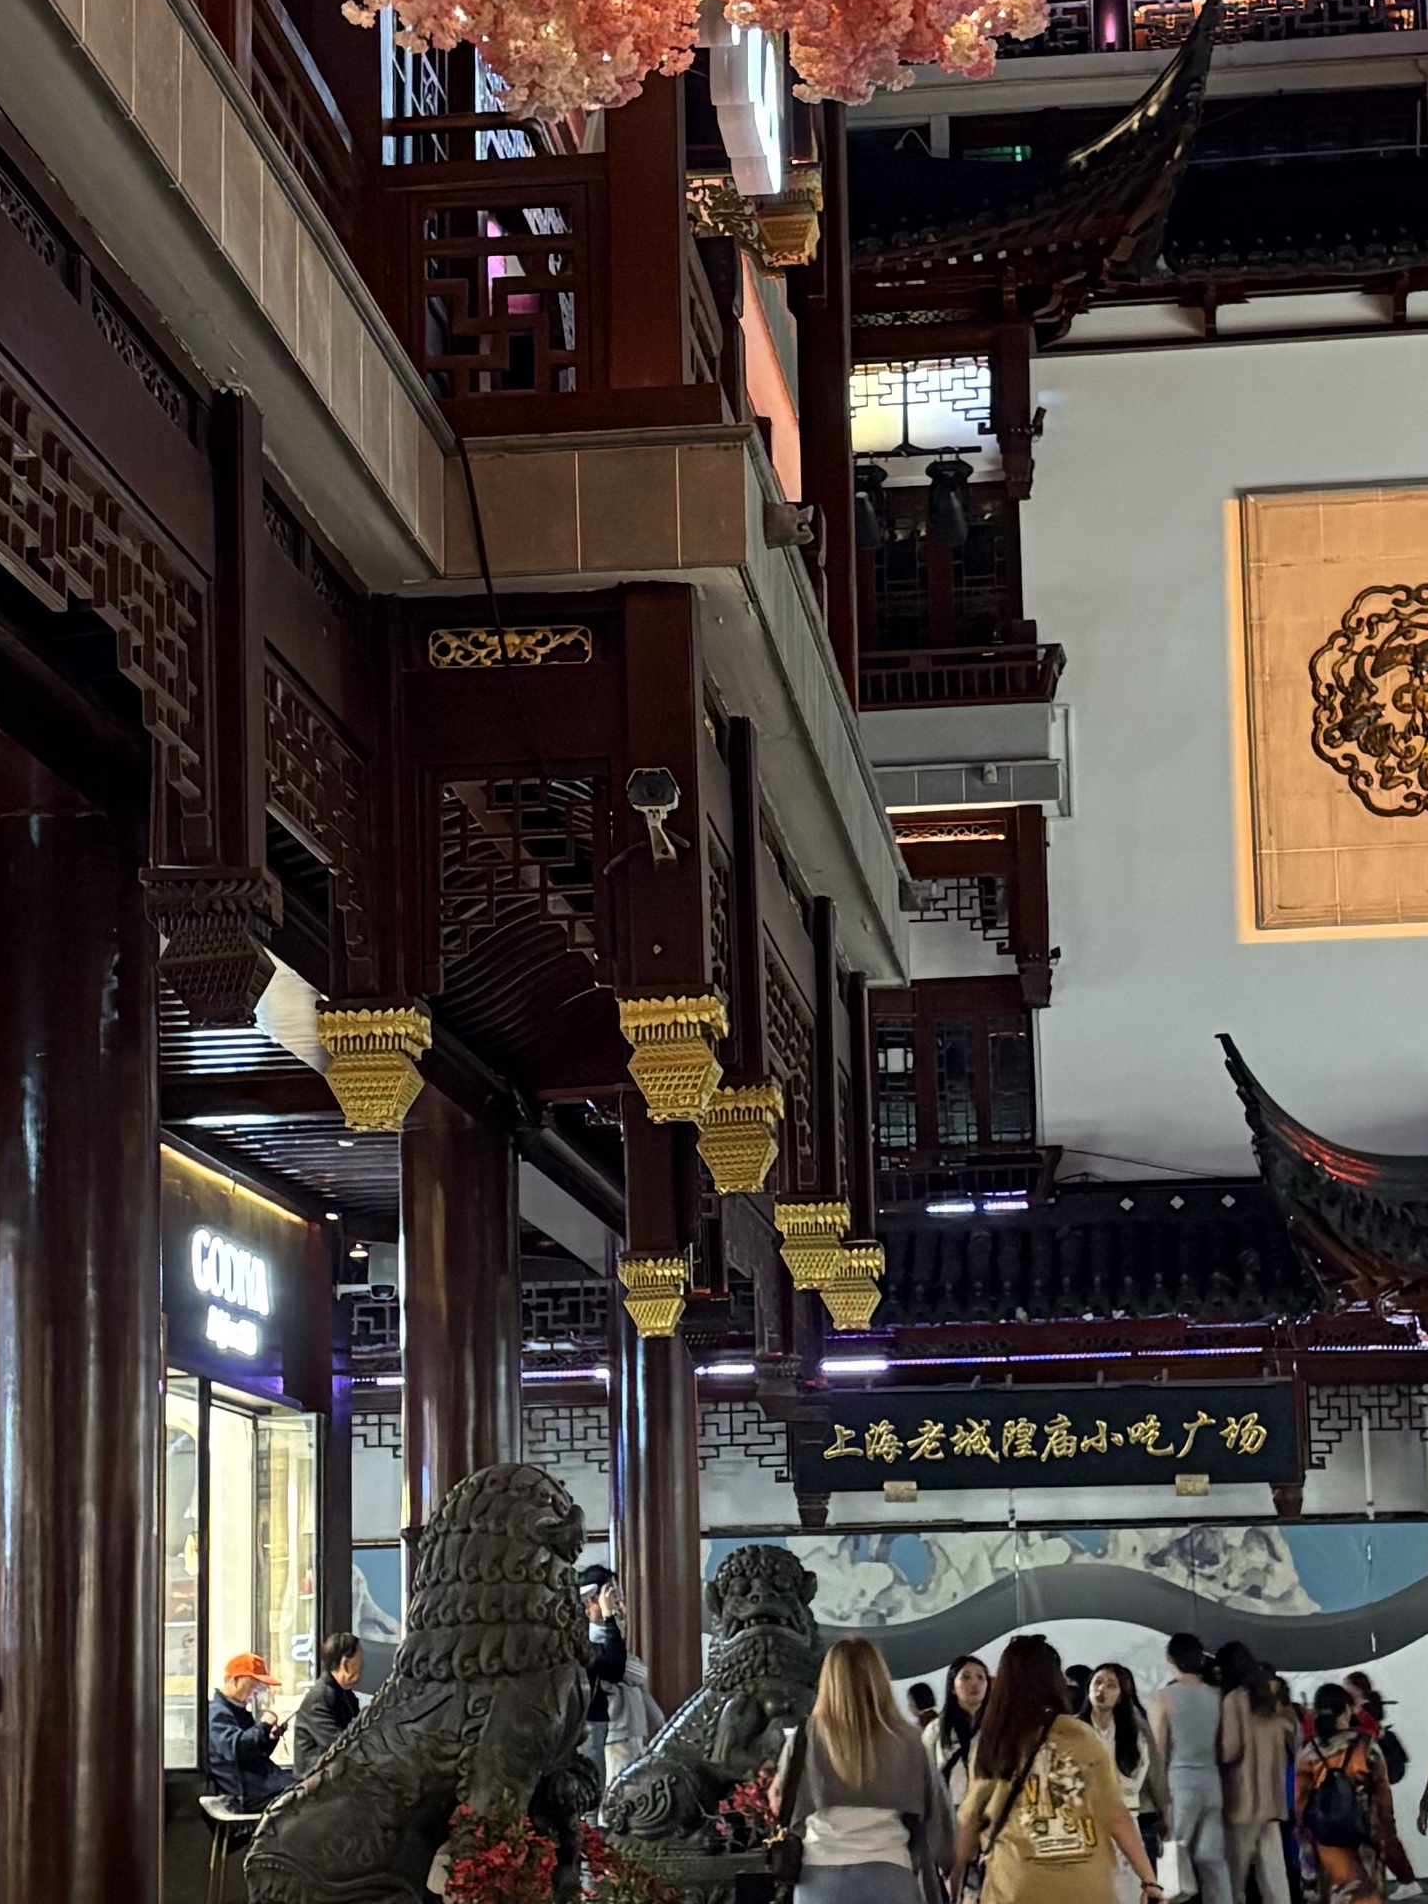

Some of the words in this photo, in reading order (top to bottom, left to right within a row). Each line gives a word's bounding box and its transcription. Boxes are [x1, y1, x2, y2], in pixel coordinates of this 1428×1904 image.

[192, 1229, 270, 1316] GODIVA
[823, 1410, 1268, 1464] 上海老城隍庙小吃广场
